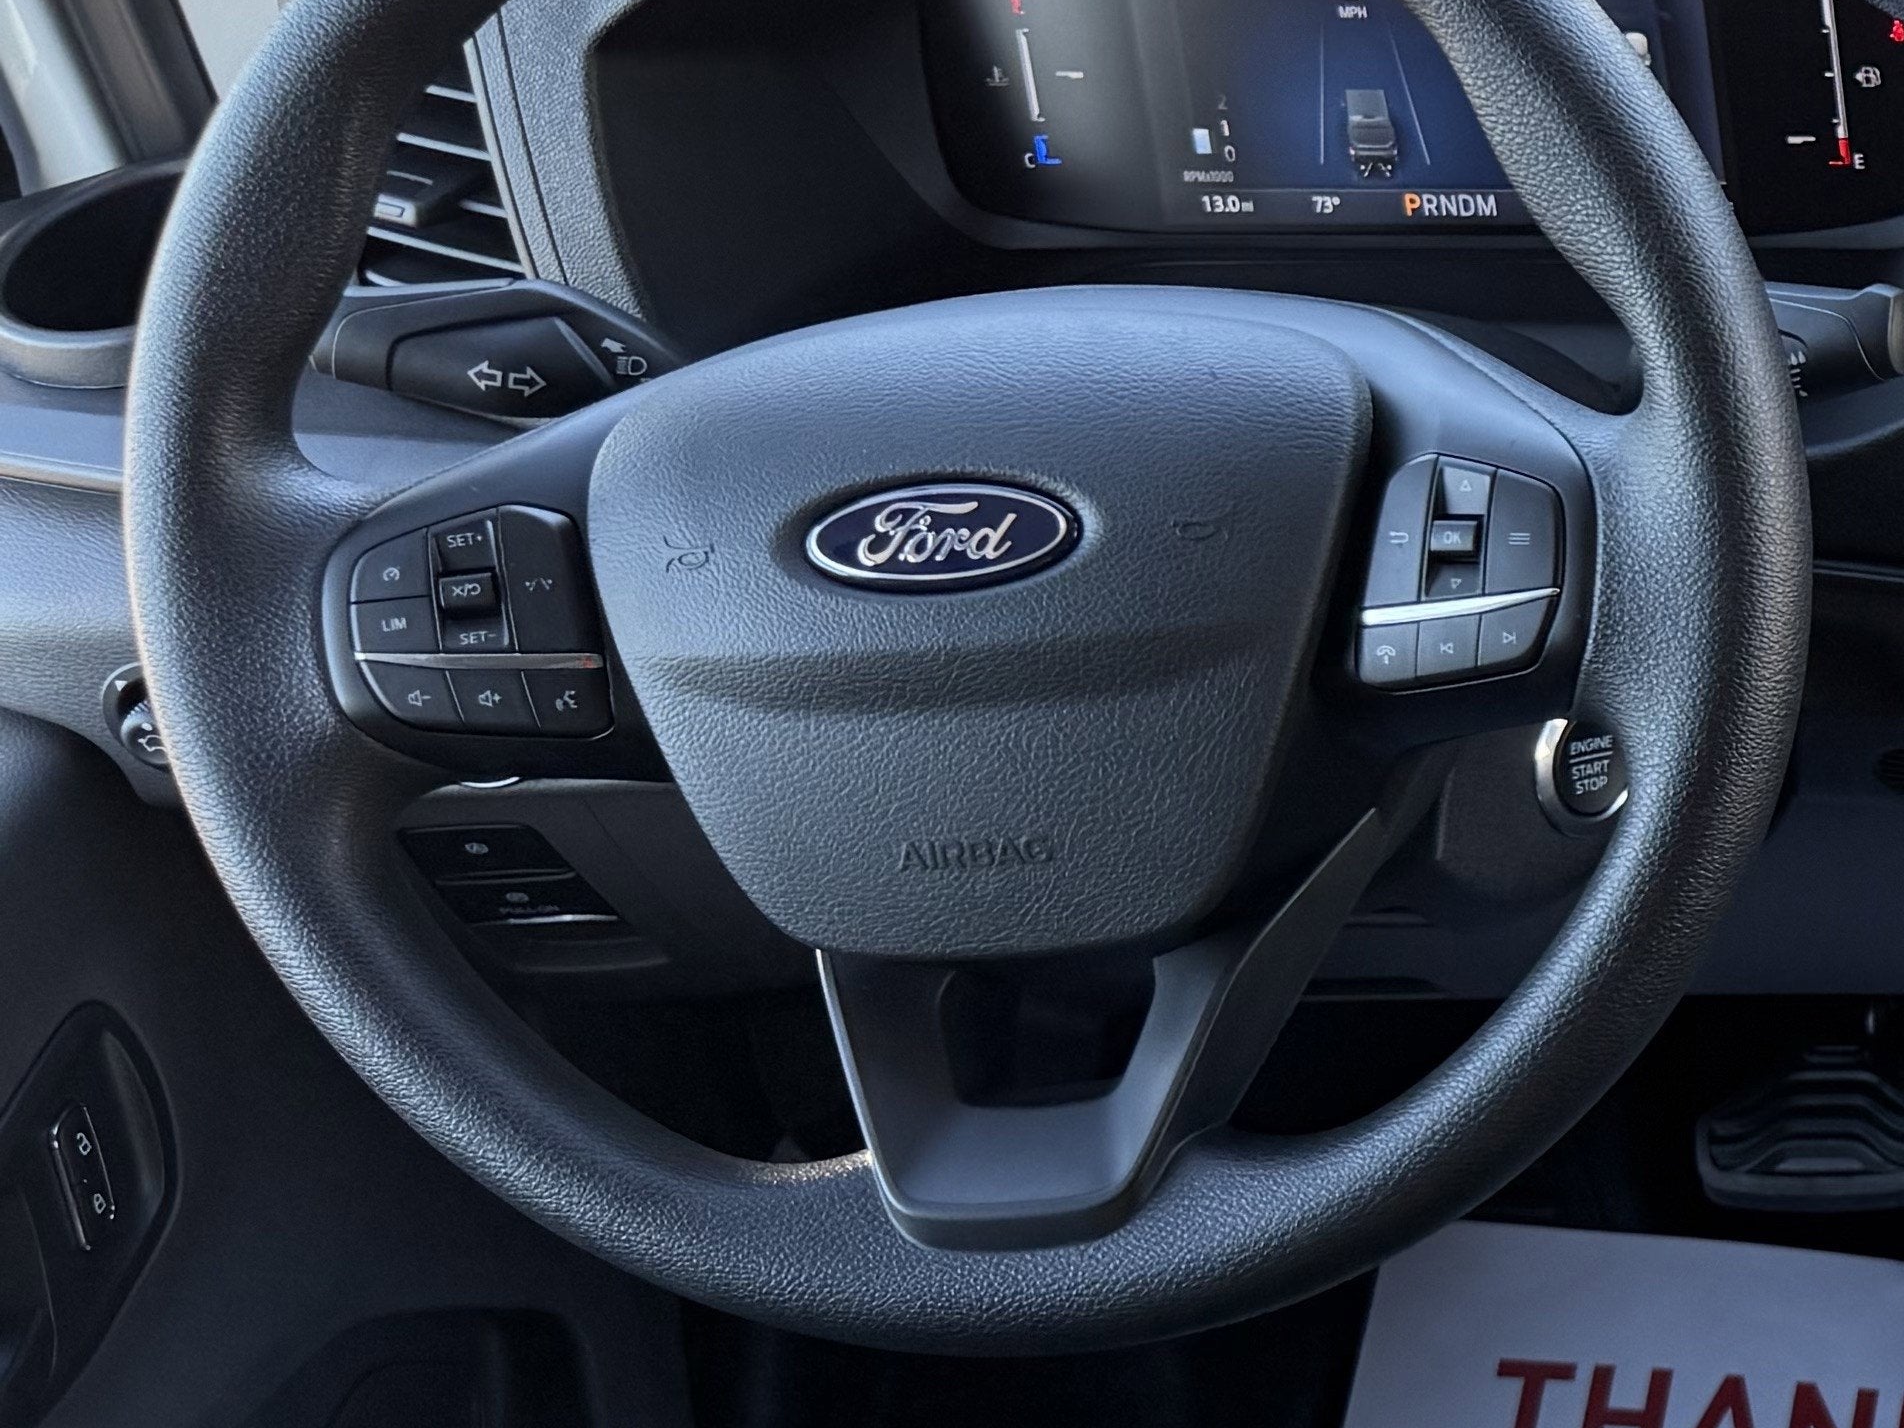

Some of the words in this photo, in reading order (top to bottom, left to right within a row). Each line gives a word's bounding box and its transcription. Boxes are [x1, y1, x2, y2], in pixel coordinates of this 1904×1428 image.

[1338, 5, 1368, 18] MPH
[1220, 119, 1230, 137] 1
[1024, 152, 1036, 169] C
[1223, 144, 1236, 163] 0
[1854, 153, 1866, 170] E
[1312, 195, 1341, 214] 73°
[446, 532, 482, 548] SET+
[857, 501, 1017, 567] Ford
[1443, 531, 1462, 545] OK
[381, 617, 407, 633] LIM
[1570, 735, 1613, 755] ENGINE
[1572, 760, 1610, 780] START
[1576, 775, 1608, 795] STOP
[898, 837, 1055, 873] AIRBAG
